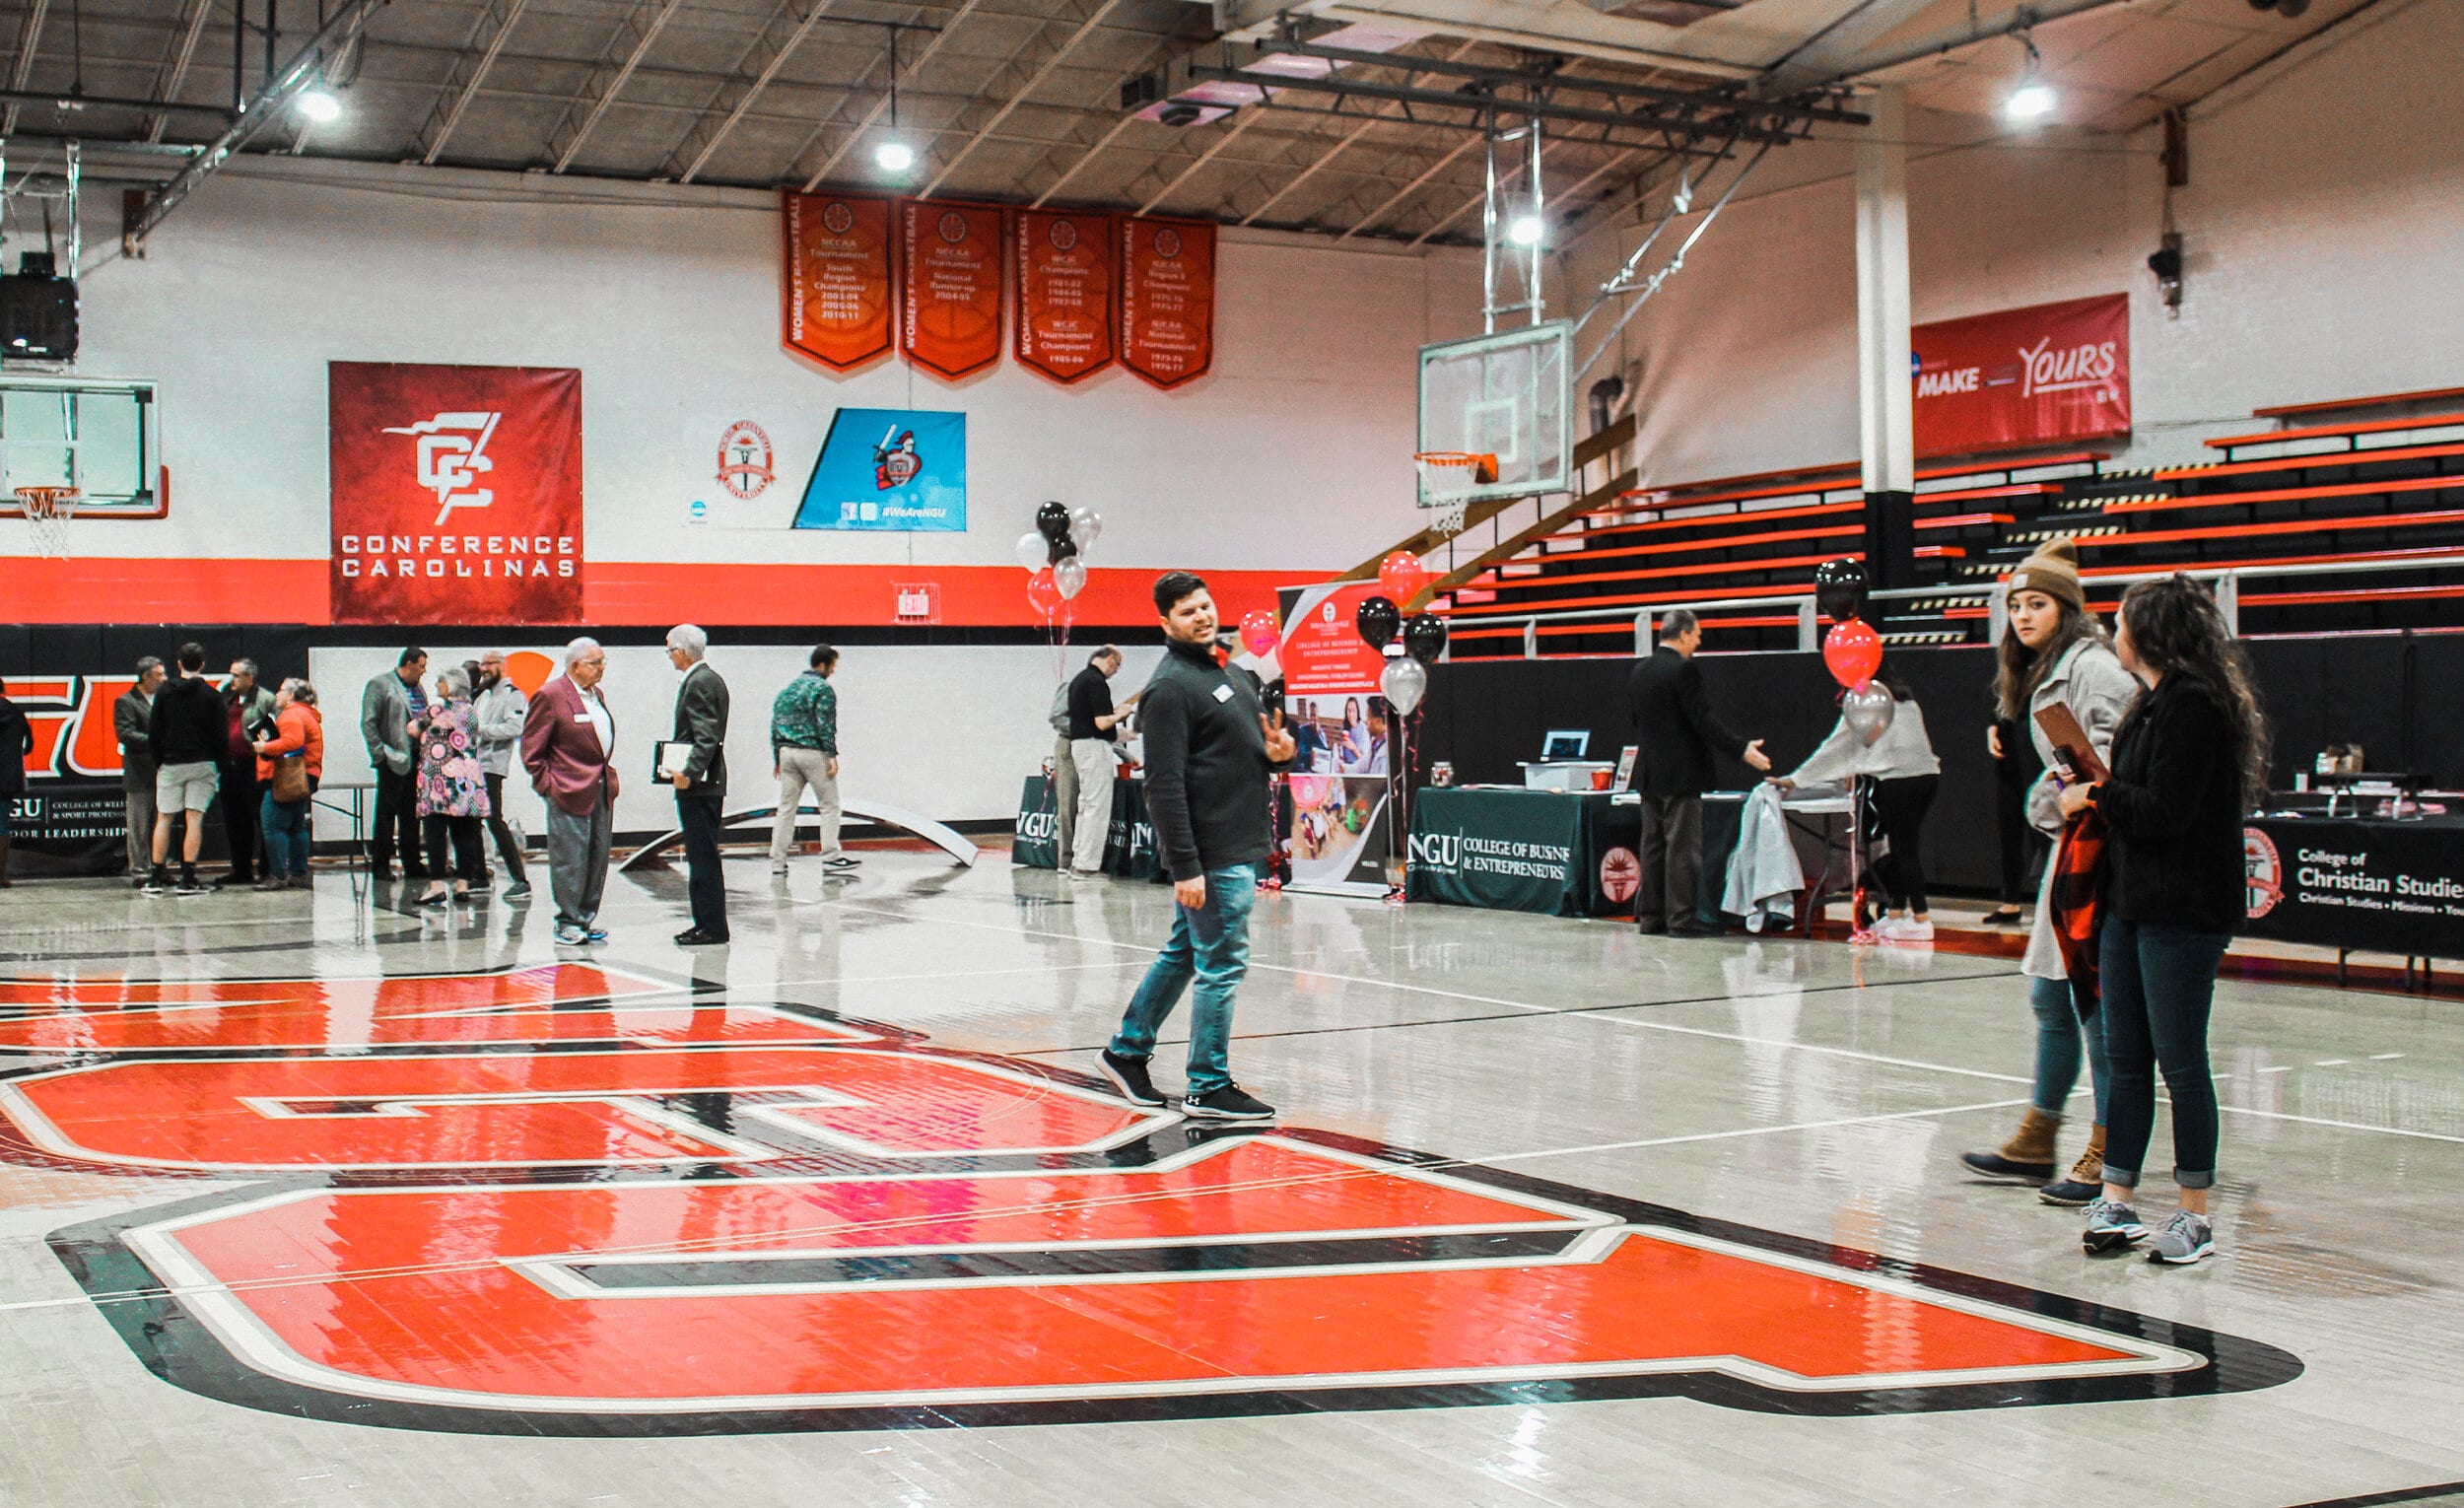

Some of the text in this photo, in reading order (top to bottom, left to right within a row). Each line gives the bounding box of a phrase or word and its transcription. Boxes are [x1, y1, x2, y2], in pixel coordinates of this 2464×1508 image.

[1917, 336, 2116, 398] MAKE YOURS
[341, 535, 574, 555] CONFERENCE
[341, 559, 575, 578] CAROLINAS
[1406, 833, 1460, 866] NGU
[1464, 838, 1511, 856] COLLEGE
[1512, 843, 1528, 857] OF
[1464, 857, 1472, 870] &
[2297, 849, 2367, 868] College of
[2297, 866, 2390, 894] Christian
[2299, 891, 2344, 906] Christian
[2347, 896, 2383, 911] Studies
[2392, 900, 2435, 915] Missions
